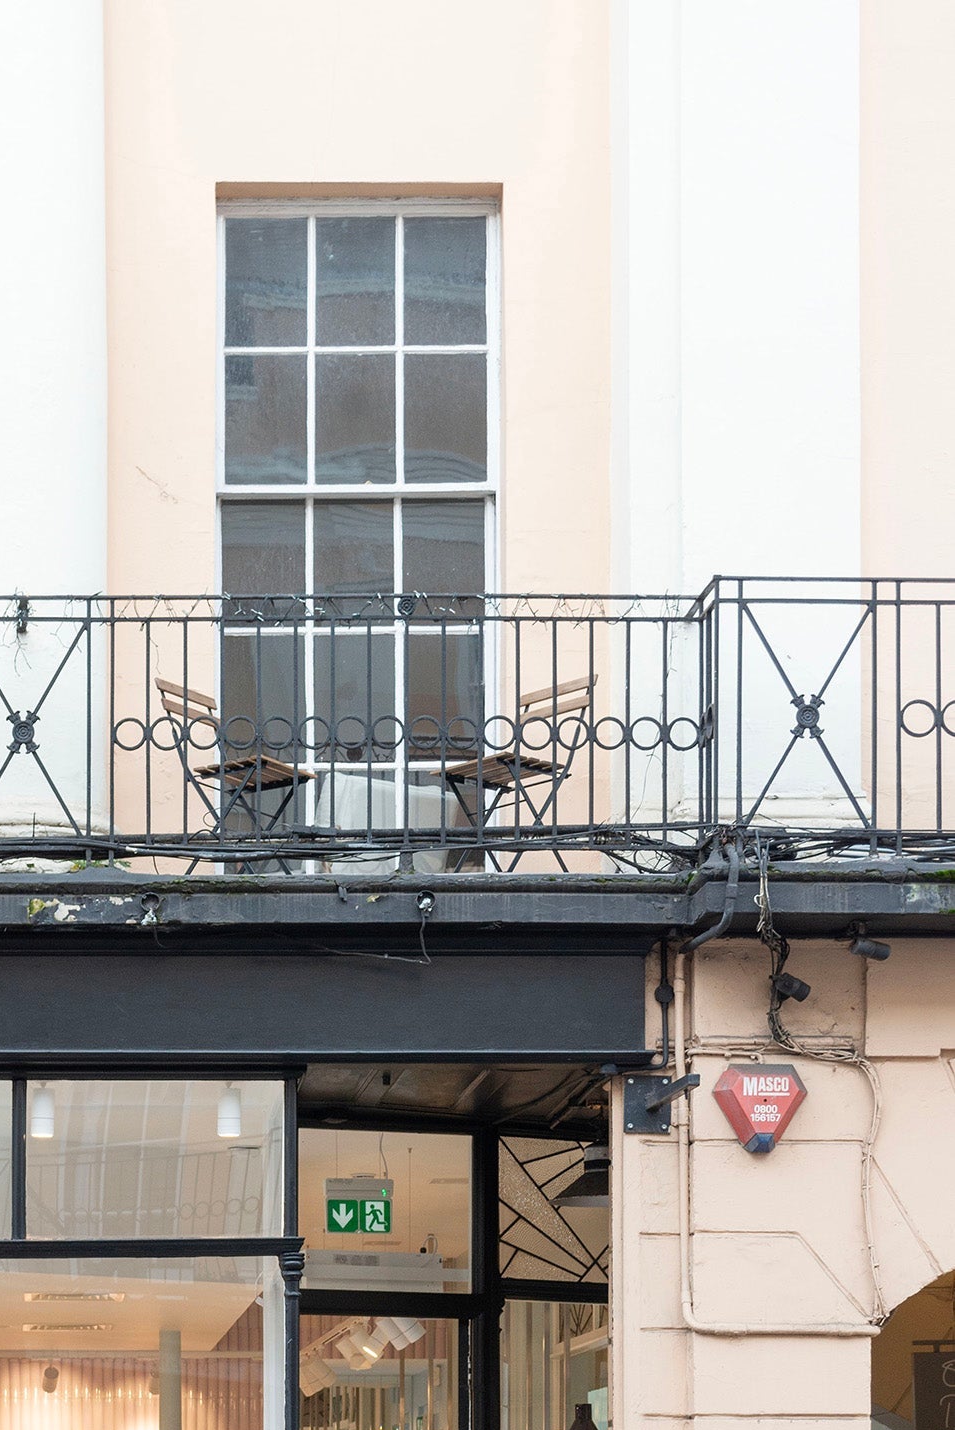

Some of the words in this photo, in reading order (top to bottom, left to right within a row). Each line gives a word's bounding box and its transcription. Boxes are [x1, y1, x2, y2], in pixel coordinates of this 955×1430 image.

[742, 1077, 790, 1096] MASCO
[753, 1105, 778, 1113] 0800
[750, 1114, 781, 1122] 156157
